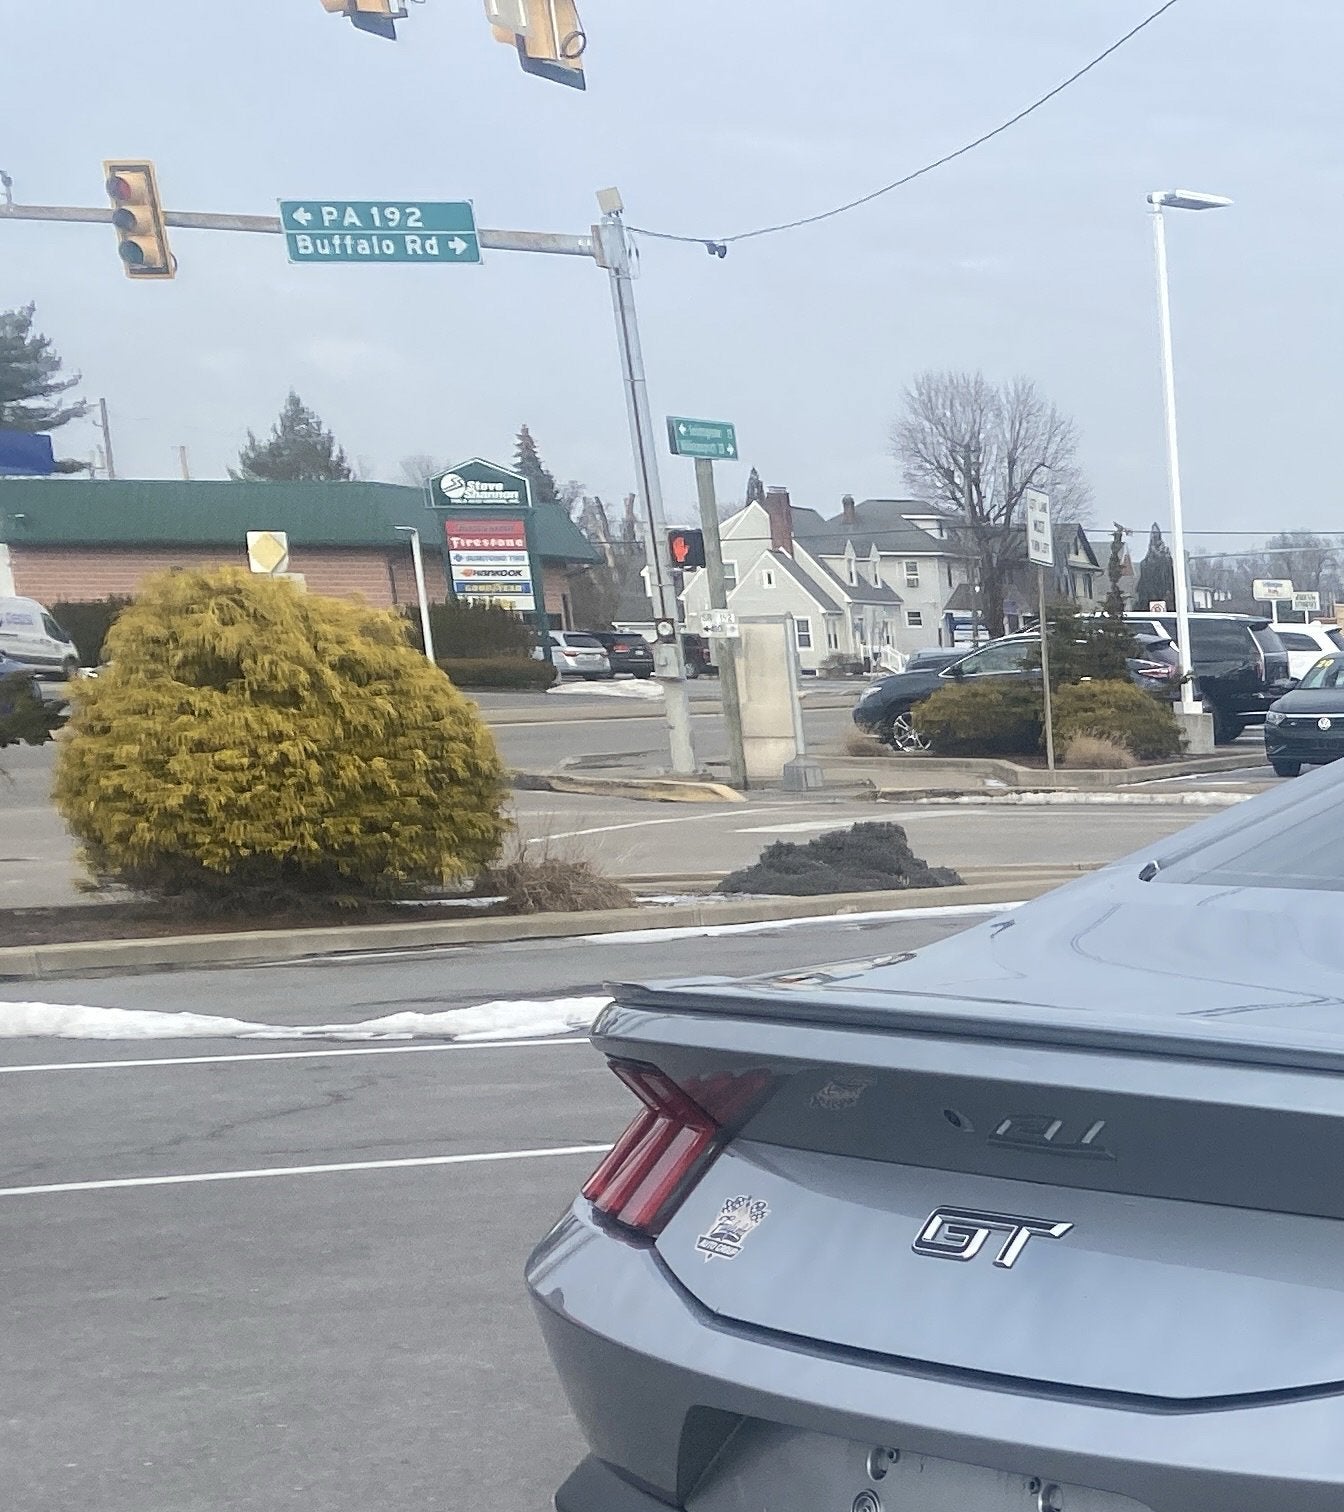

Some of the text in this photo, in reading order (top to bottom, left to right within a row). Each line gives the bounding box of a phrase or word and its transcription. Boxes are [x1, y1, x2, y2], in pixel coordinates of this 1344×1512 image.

[321, 206, 424, 228] PA 192
[295, 234, 439, 256] Buffalo Rd
[466, 480, 504, 490] Steve
[450, 536, 524, 549] Firestone
[912, 1205, 1074, 1269] GT
